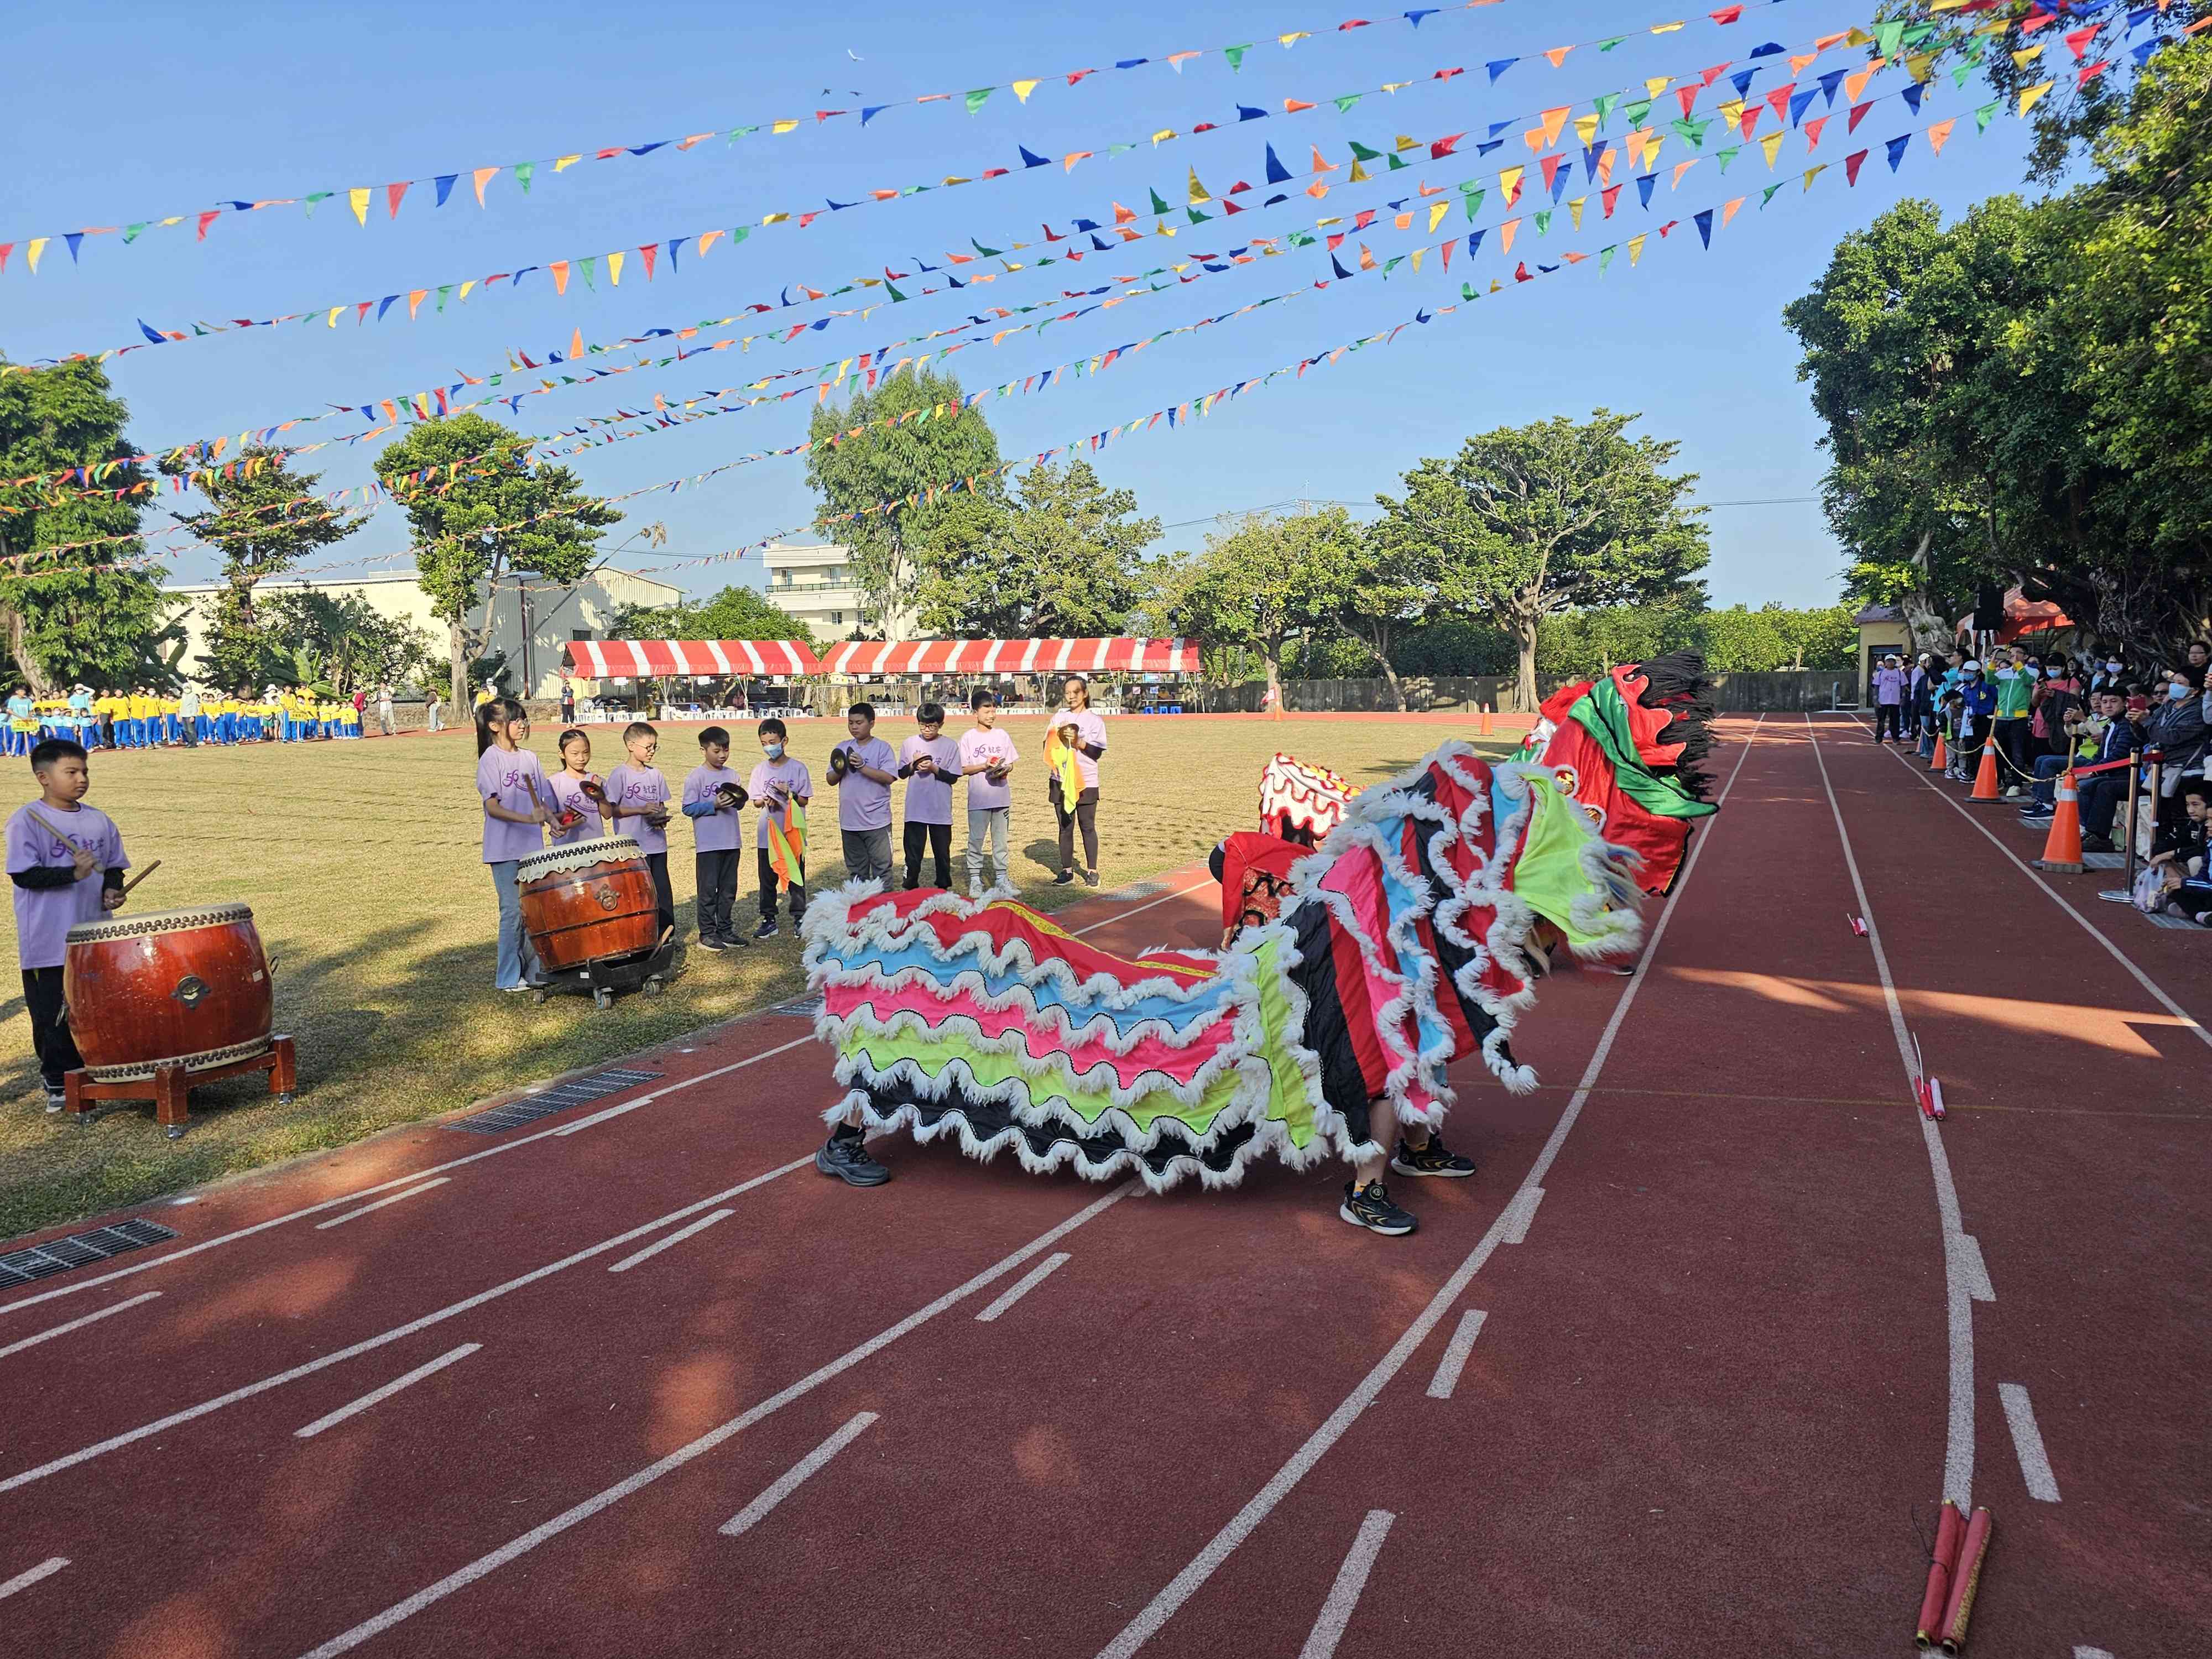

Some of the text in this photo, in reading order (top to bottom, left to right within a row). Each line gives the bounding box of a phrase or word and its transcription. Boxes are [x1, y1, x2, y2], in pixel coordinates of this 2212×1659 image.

[973, 743, 987, 758] 56
[502, 769, 519, 787] 56
[625, 782, 641, 799] 56
